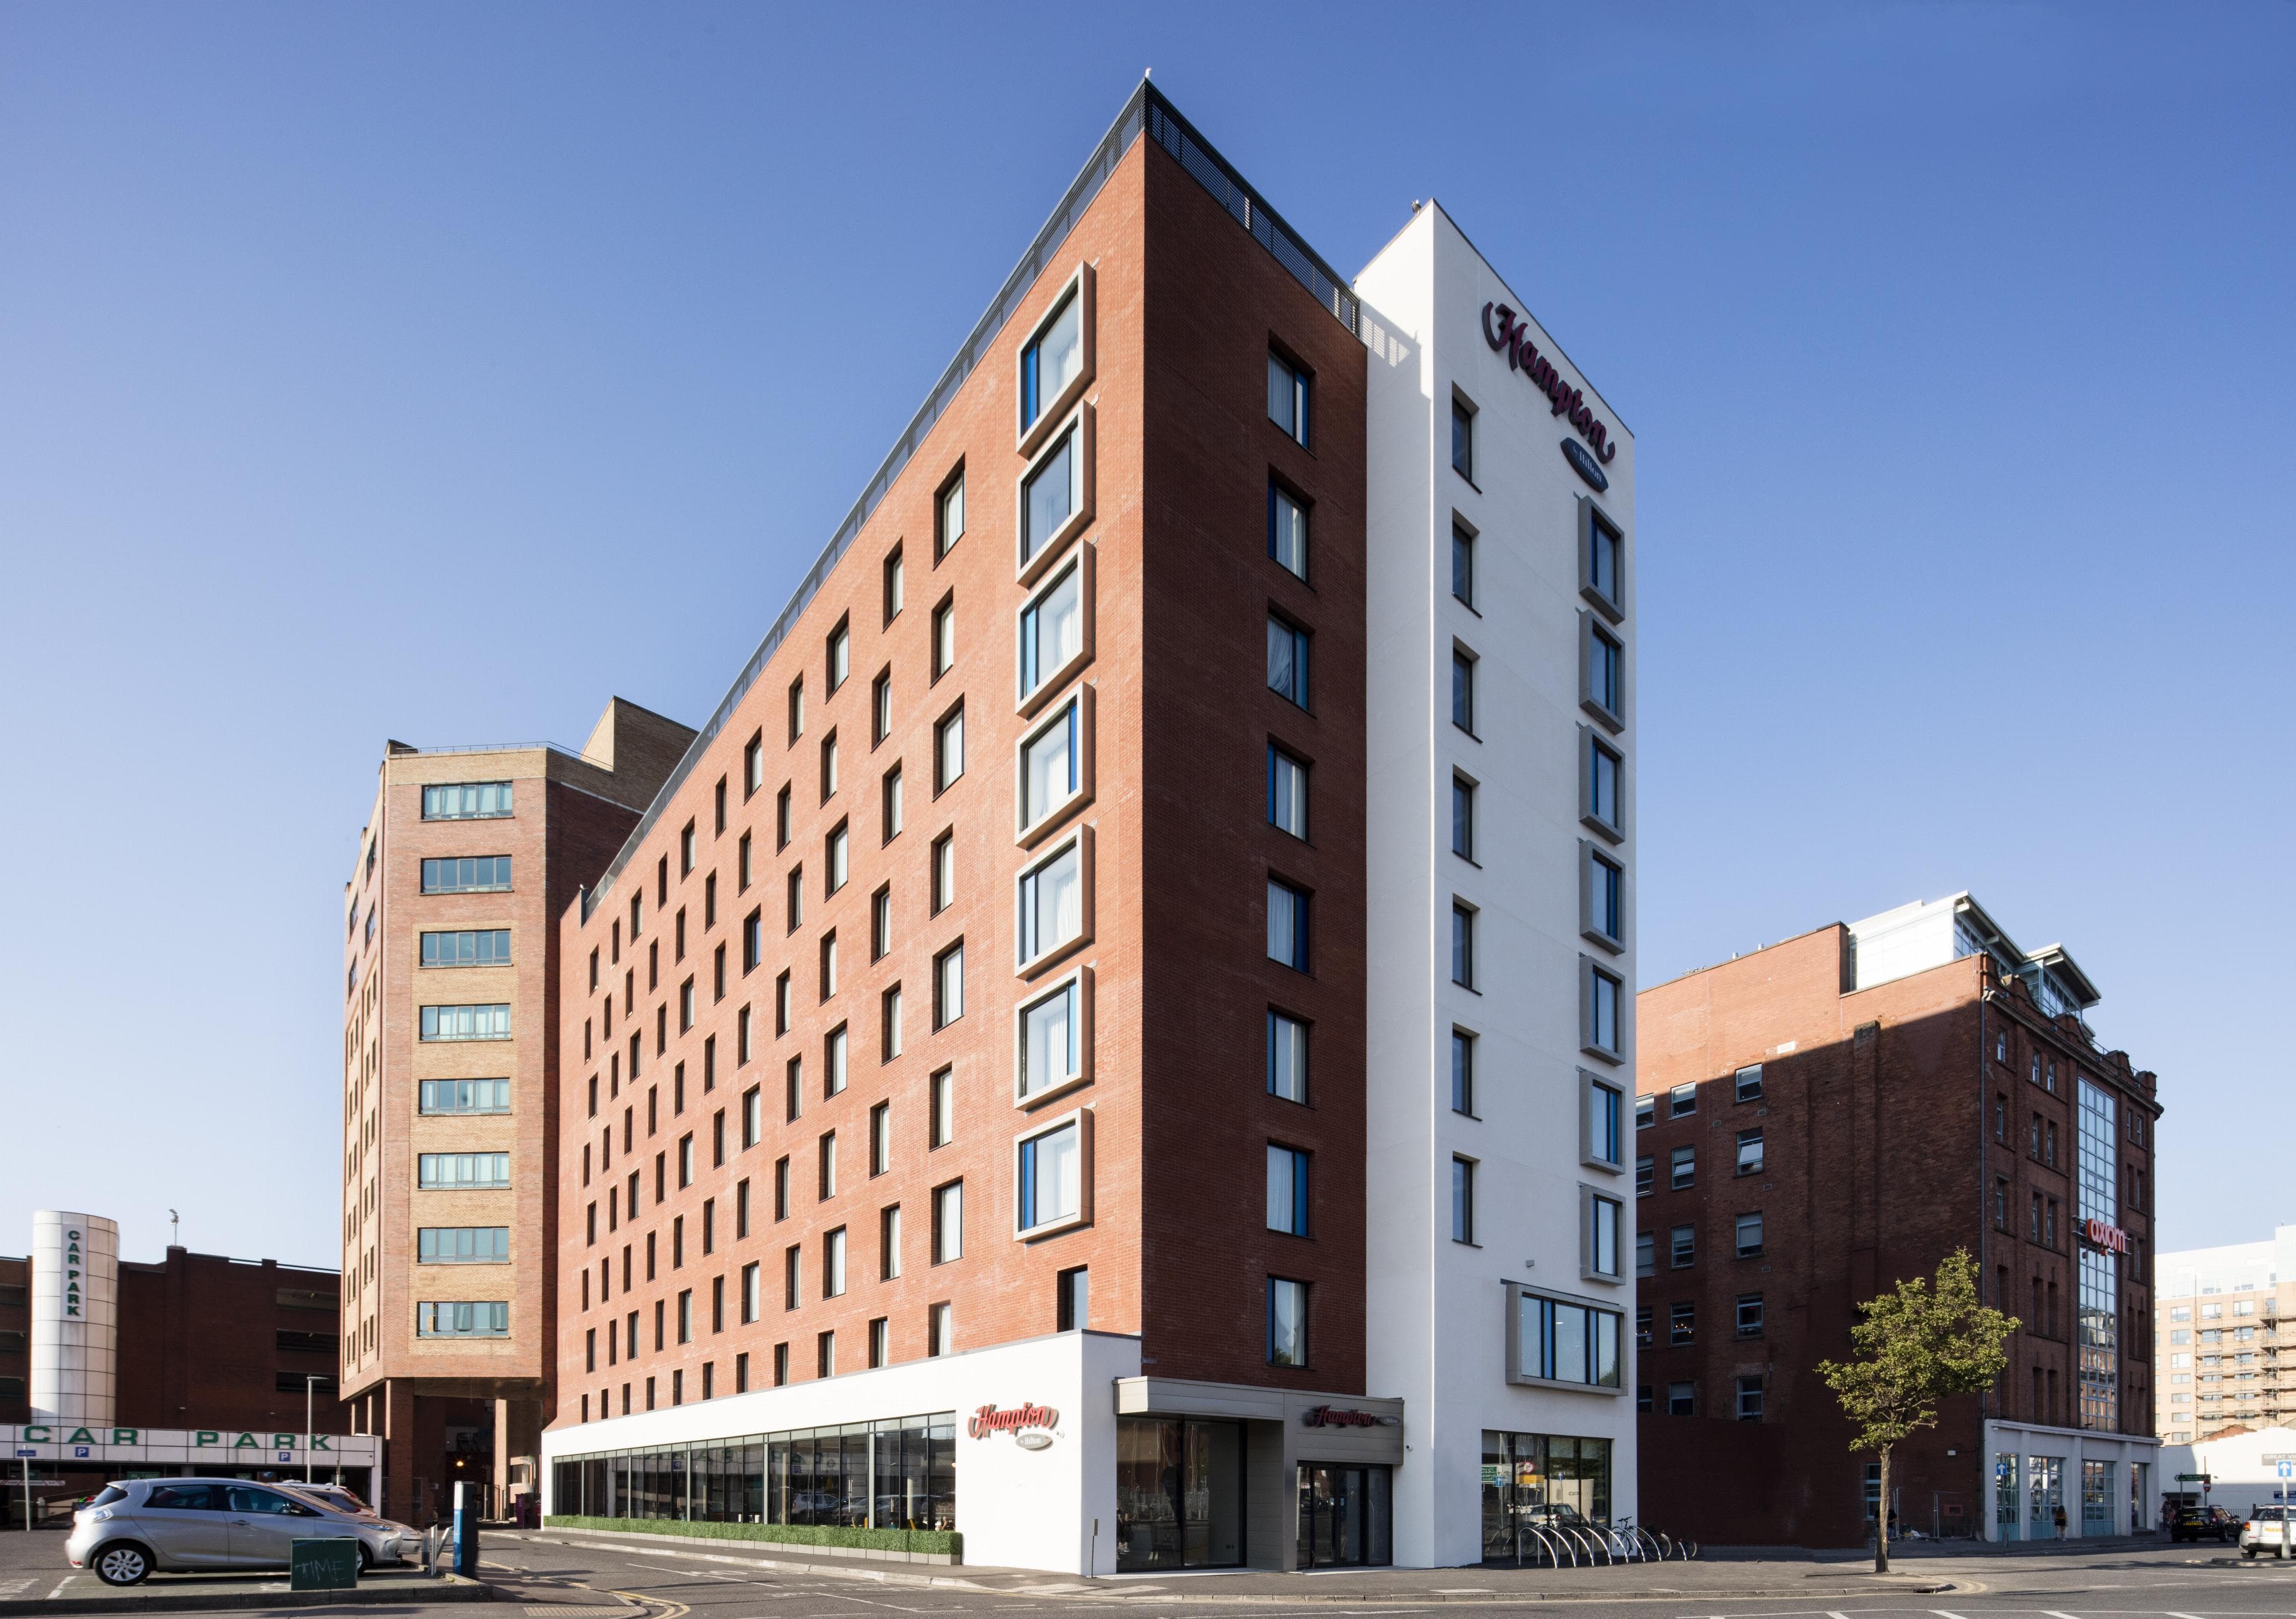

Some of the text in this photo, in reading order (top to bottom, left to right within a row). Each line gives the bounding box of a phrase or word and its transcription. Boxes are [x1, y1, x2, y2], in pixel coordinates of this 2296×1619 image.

[1482, 301, 1616, 464] Hampton
[1580, 451, 1601, 483] Hilton
[67, 1230, 80, 1316] CAR PARK
[968, 1402, 1056, 1438] Hampton
[1309, 1405, 1375, 1428] Hampton
[23, 1425, 331, 1450] CAR PARK
[1025, 1437, 1041, 1445] Hilton
[78, 1448, 86, 1456] P
[295, 1558, 347, 1583] TIME
